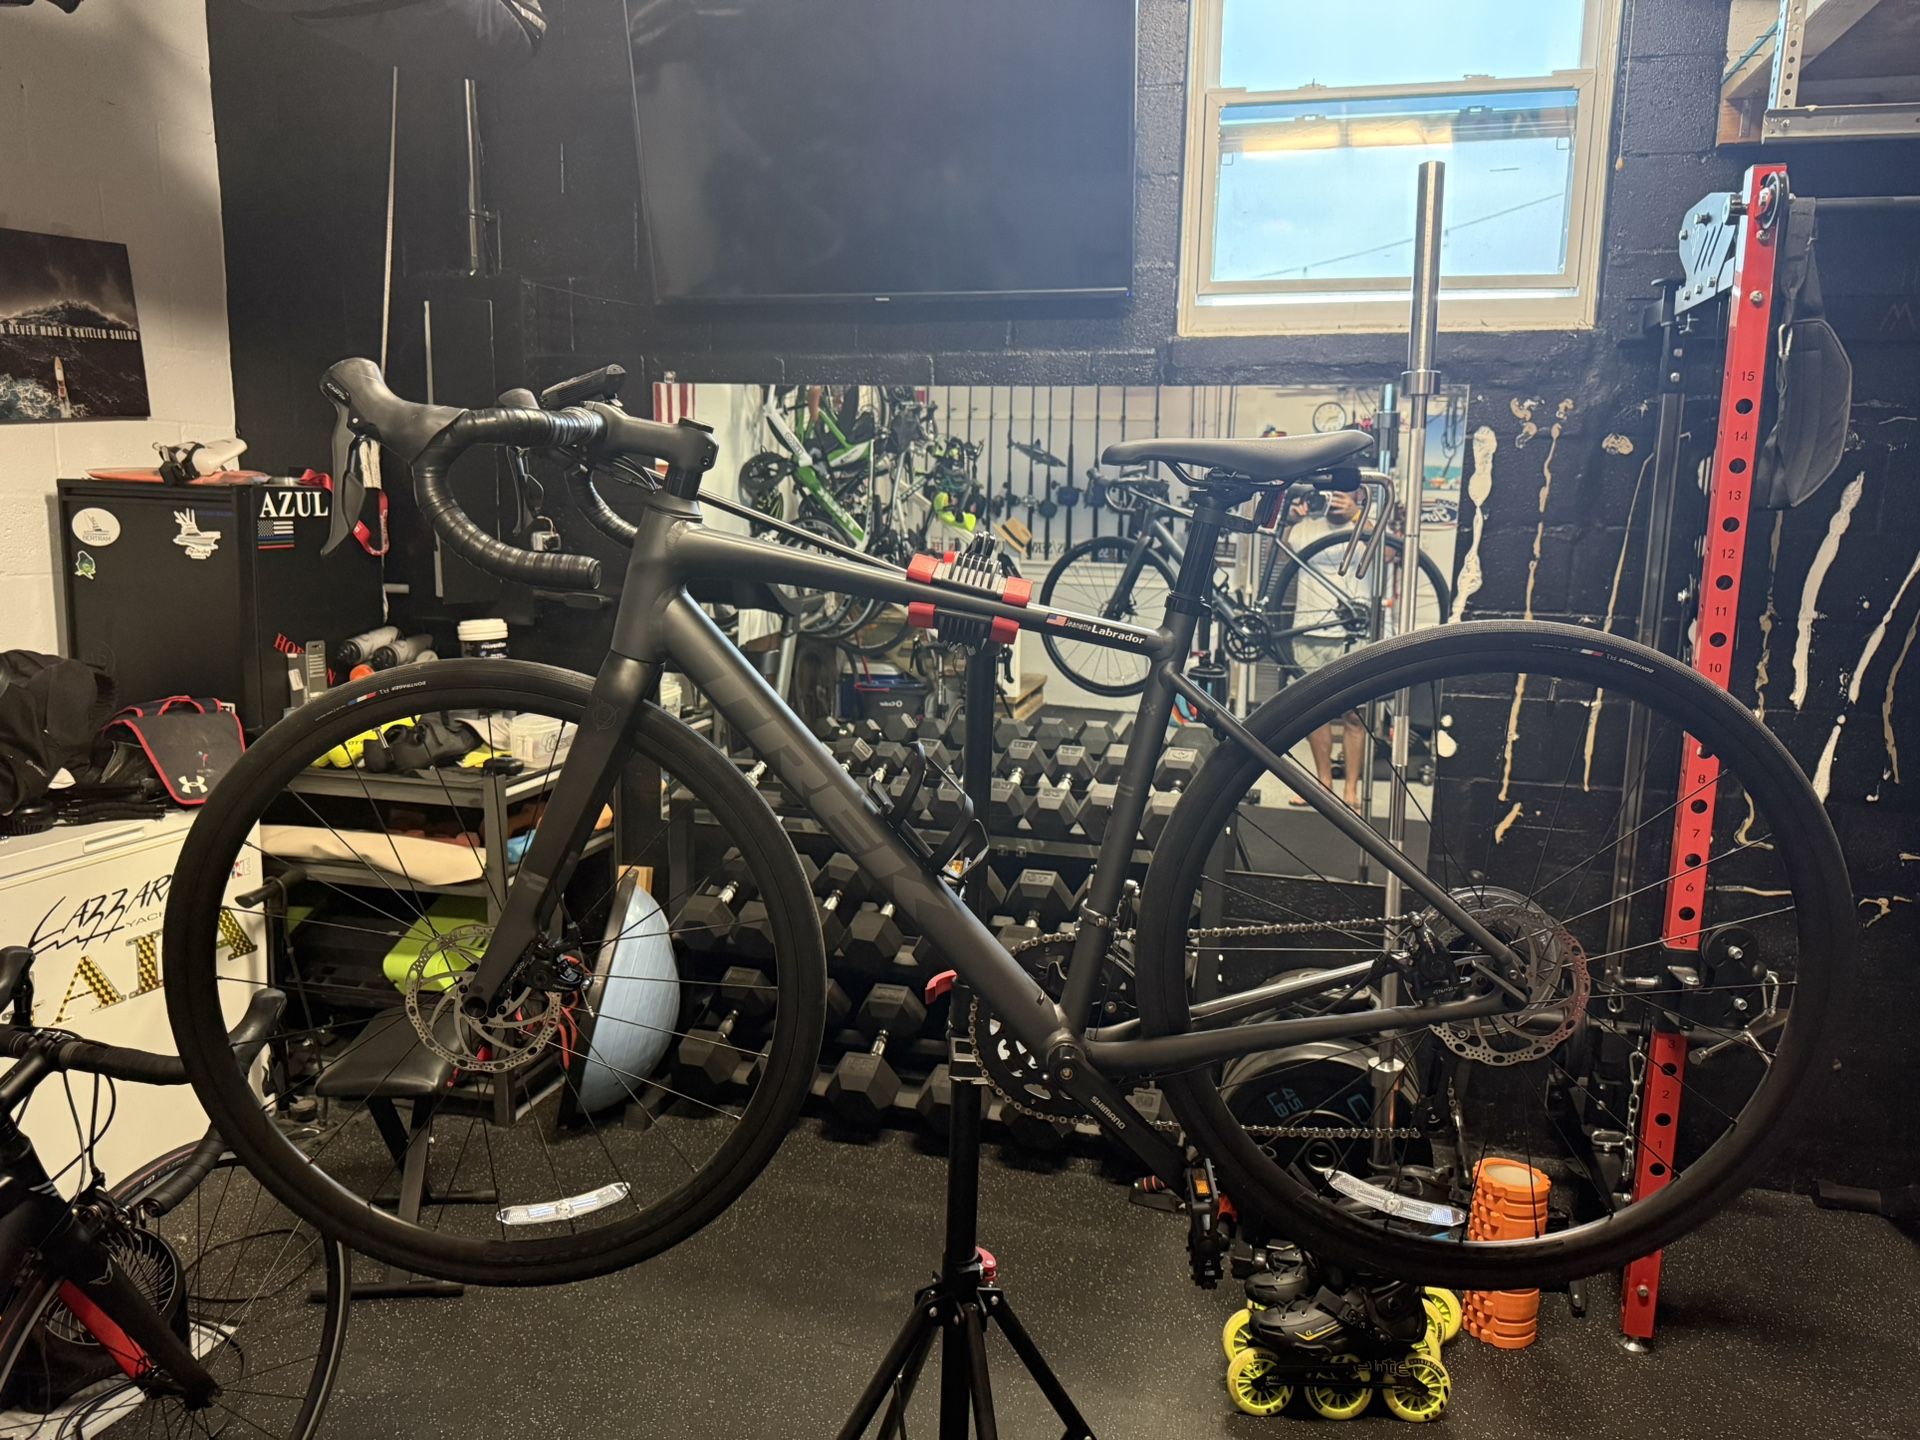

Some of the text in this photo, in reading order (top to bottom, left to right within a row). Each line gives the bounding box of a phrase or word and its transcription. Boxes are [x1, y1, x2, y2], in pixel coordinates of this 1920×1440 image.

[9, 324, 37, 335] NEVER
[40, 326, 63, 336] MADE
[66, 328, 72, 337] A
[74, 328, 107, 339] SKILLED
[110, 329, 138, 340] SAILOR
[1741, 371, 1755, 382] 15
[1735, 431, 1748, 441] 14
[1728, 490, 1742, 500] 13
[259, 491, 329, 518] AZUL
[1721, 548, 1735, 559] 12
[1714, 606, 1728, 617] 11
[1091, 624, 1145, 645] Labrador
[1619, 658, 1655, 674] BONTRAGER
[1708, 663, 1722, 673] 10
[391, 680, 427, 692] BONTRAGER
[1698, 774, 1706, 784] 8
[703, 650, 948, 926] TREK
[1692, 828, 1700, 839] 7
[1685, 882, 1694, 892] 6
[28, 873, 174, 950] LAZZAR
[1680, 936, 1688, 945] 5
[1668, 1040, 1675, 1049] 3
[1281, 1087, 1304, 1112] 45
[1662, 1090, 1670, 1099] 2
[1266, 1091, 1289, 1118] LB
[1091, 1096, 1126, 1130] SHIMANO
